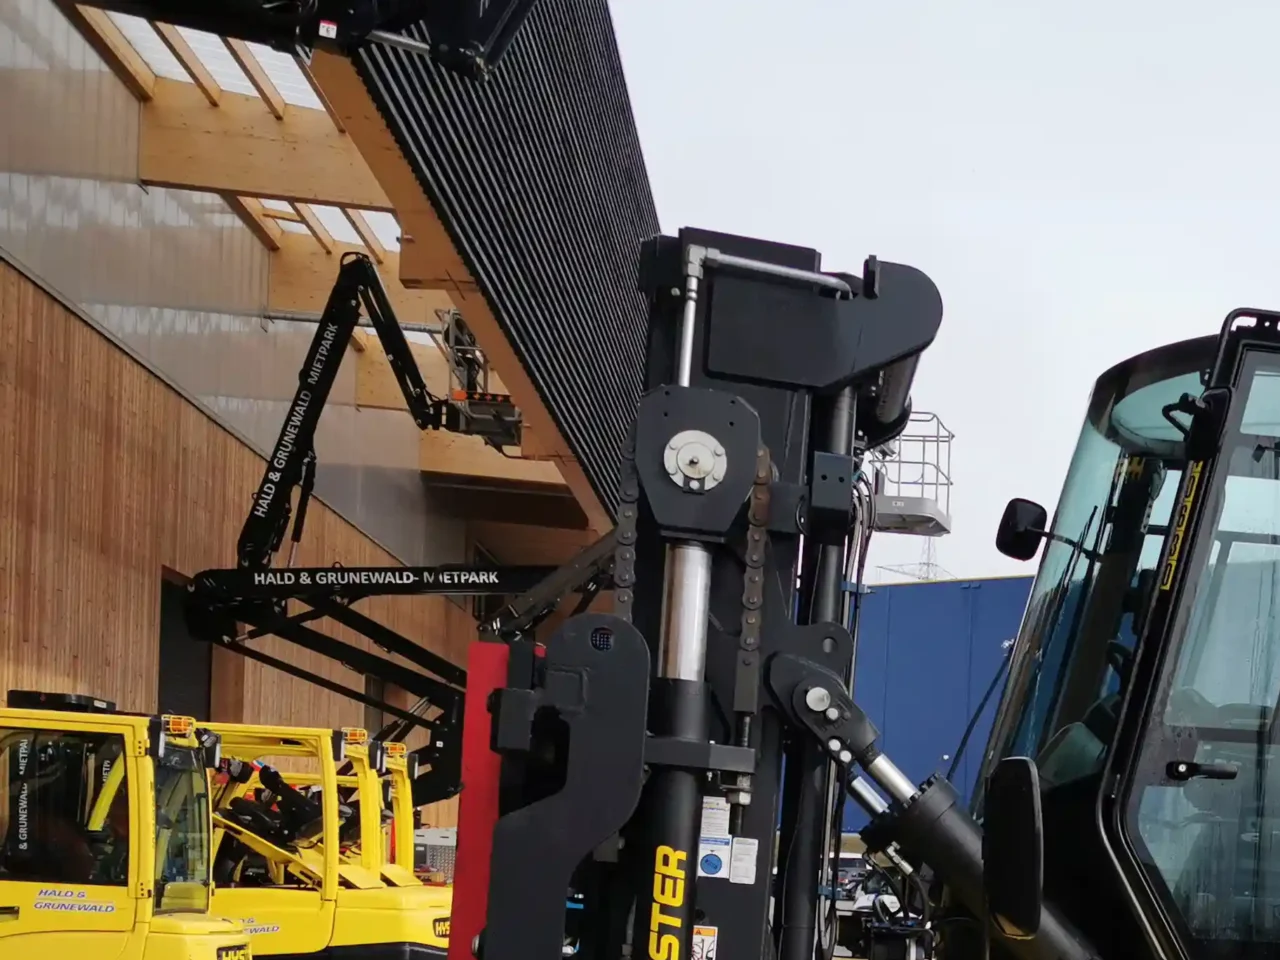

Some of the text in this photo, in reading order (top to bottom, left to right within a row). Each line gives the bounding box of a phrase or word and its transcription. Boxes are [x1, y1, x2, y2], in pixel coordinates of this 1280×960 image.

[254, 322, 339, 517] HALD & GRUNEWALD MIETPARK
[254, 572, 295, 585] HALD
[299, 572, 312, 584] &
[38, 889, 74, 898] HALD
[34, 901, 115, 912] GRUNEWALD
